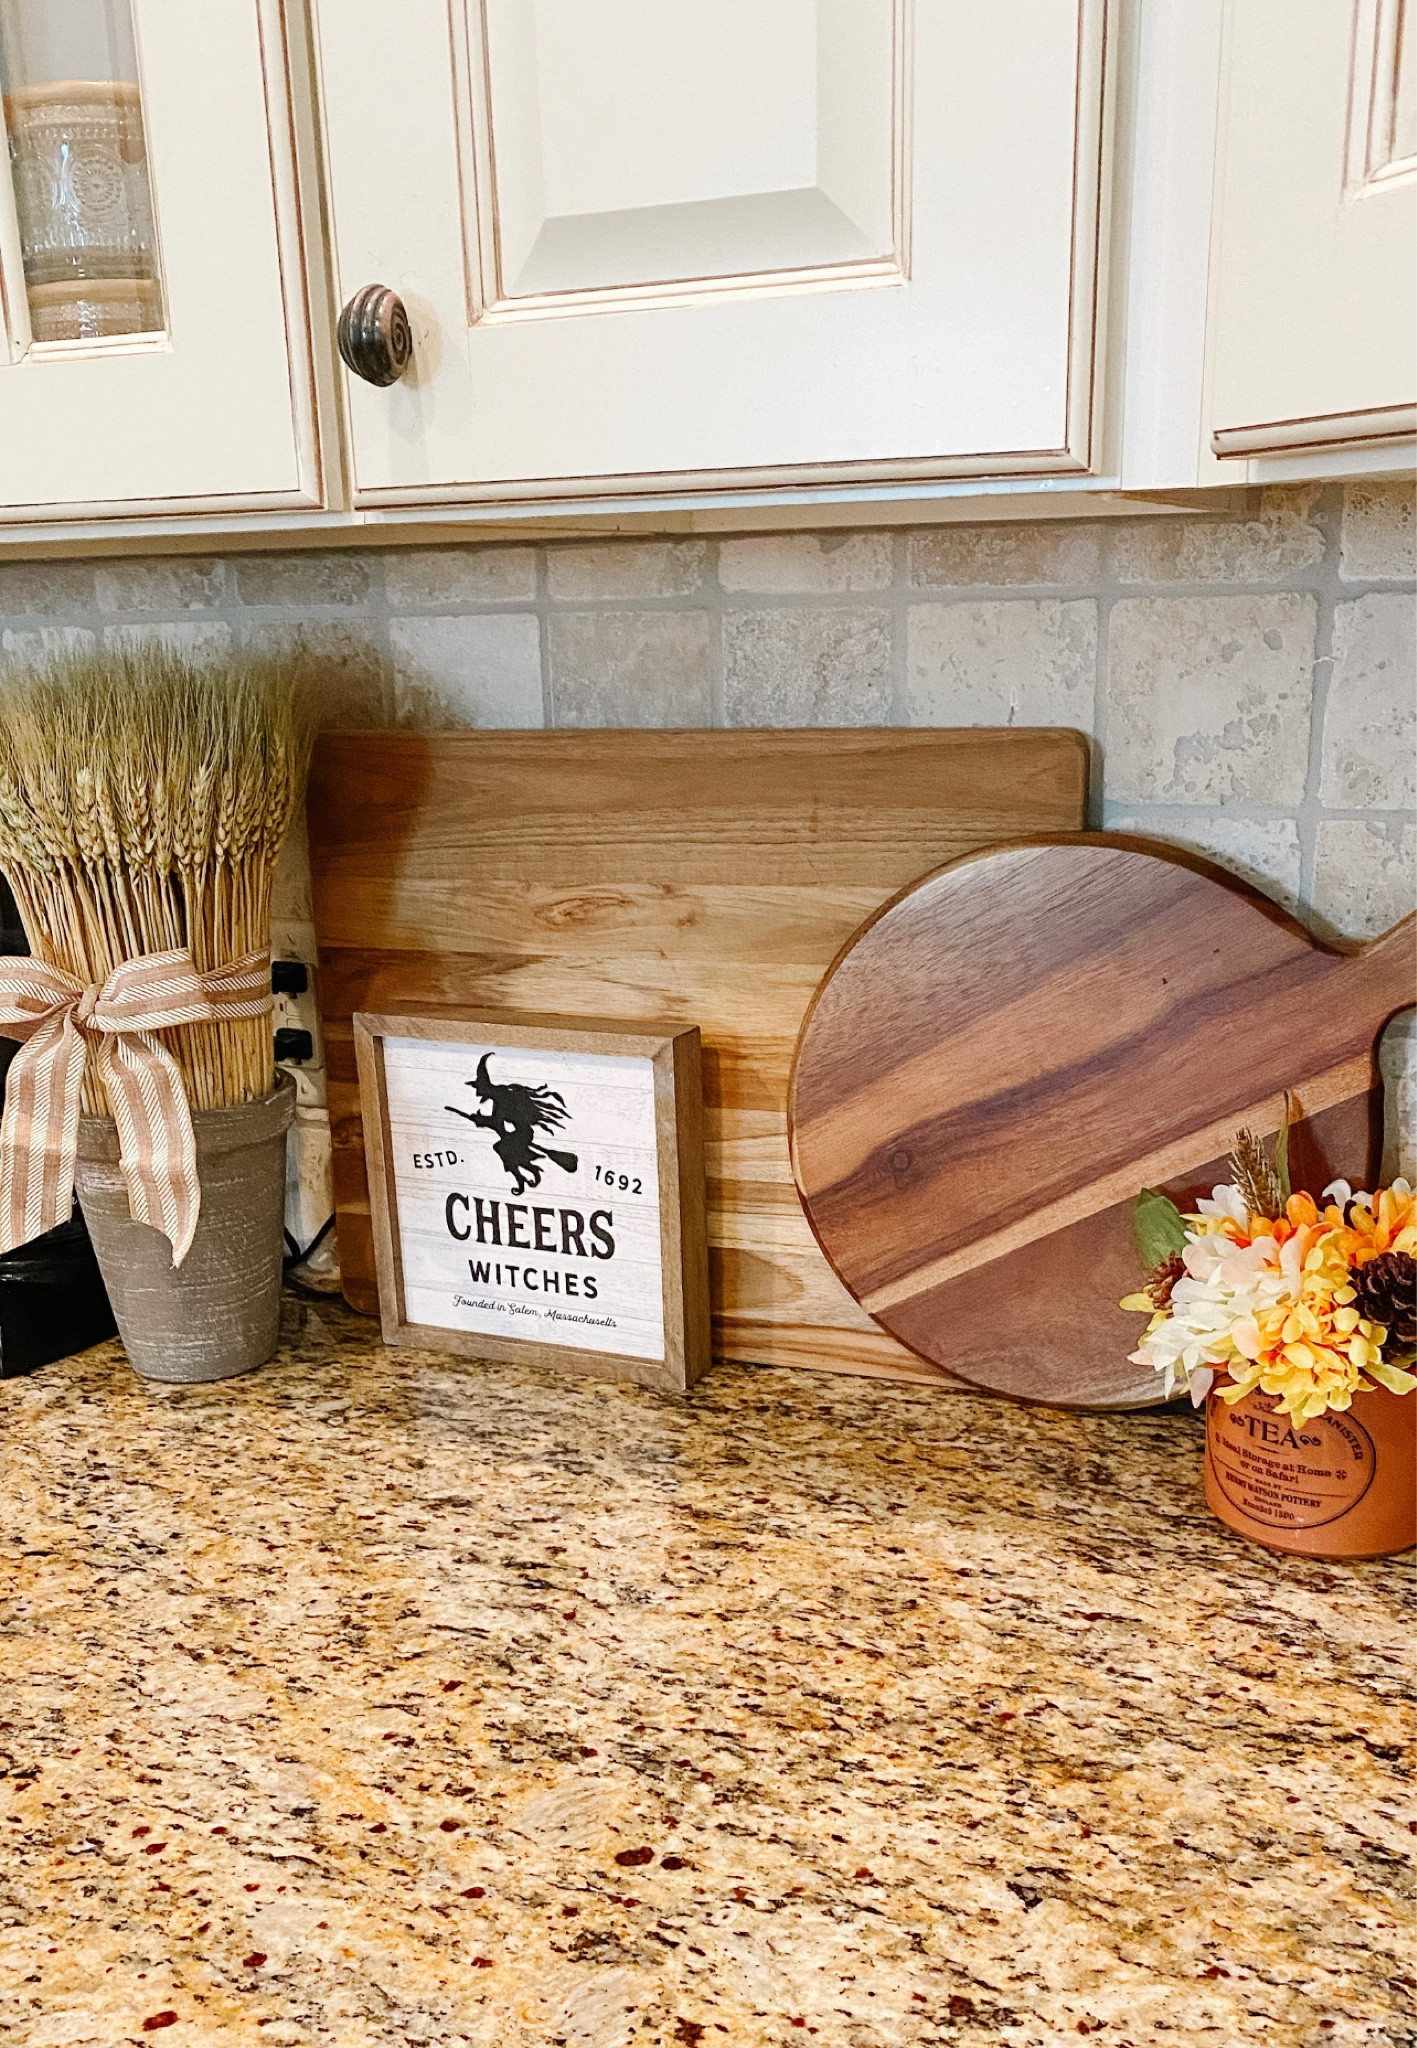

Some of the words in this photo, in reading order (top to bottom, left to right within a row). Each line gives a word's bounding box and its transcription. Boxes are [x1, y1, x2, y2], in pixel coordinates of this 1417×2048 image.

[413, 1150, 464, 1169] ESTD.
[594, 1165, 643, 1195] 1692
[445, 1192, 616, 1260] CHEERS
[468, 1260, 598, 1299] WITCHES
[453, 1294, 496, 1310] Founded
[496, 1302, 507, 1312] in
[507, 1302, 542, 1318] Salem,
[543, 1308, 618, 1328] Massachusetts
[1244, 1414, 1301, 1450] TEA
[1318, 1415, 1364, 1461] ANISTER
[1242, 1448, 1281, 1469] Storage
[1282, 1463, 1295, 1473] at
[1297, 1465, 1332, 1478] Home
[1265, 1468, 1299, 1484] Safari
[1281, 1493, 1322, 1509] POTTERY
